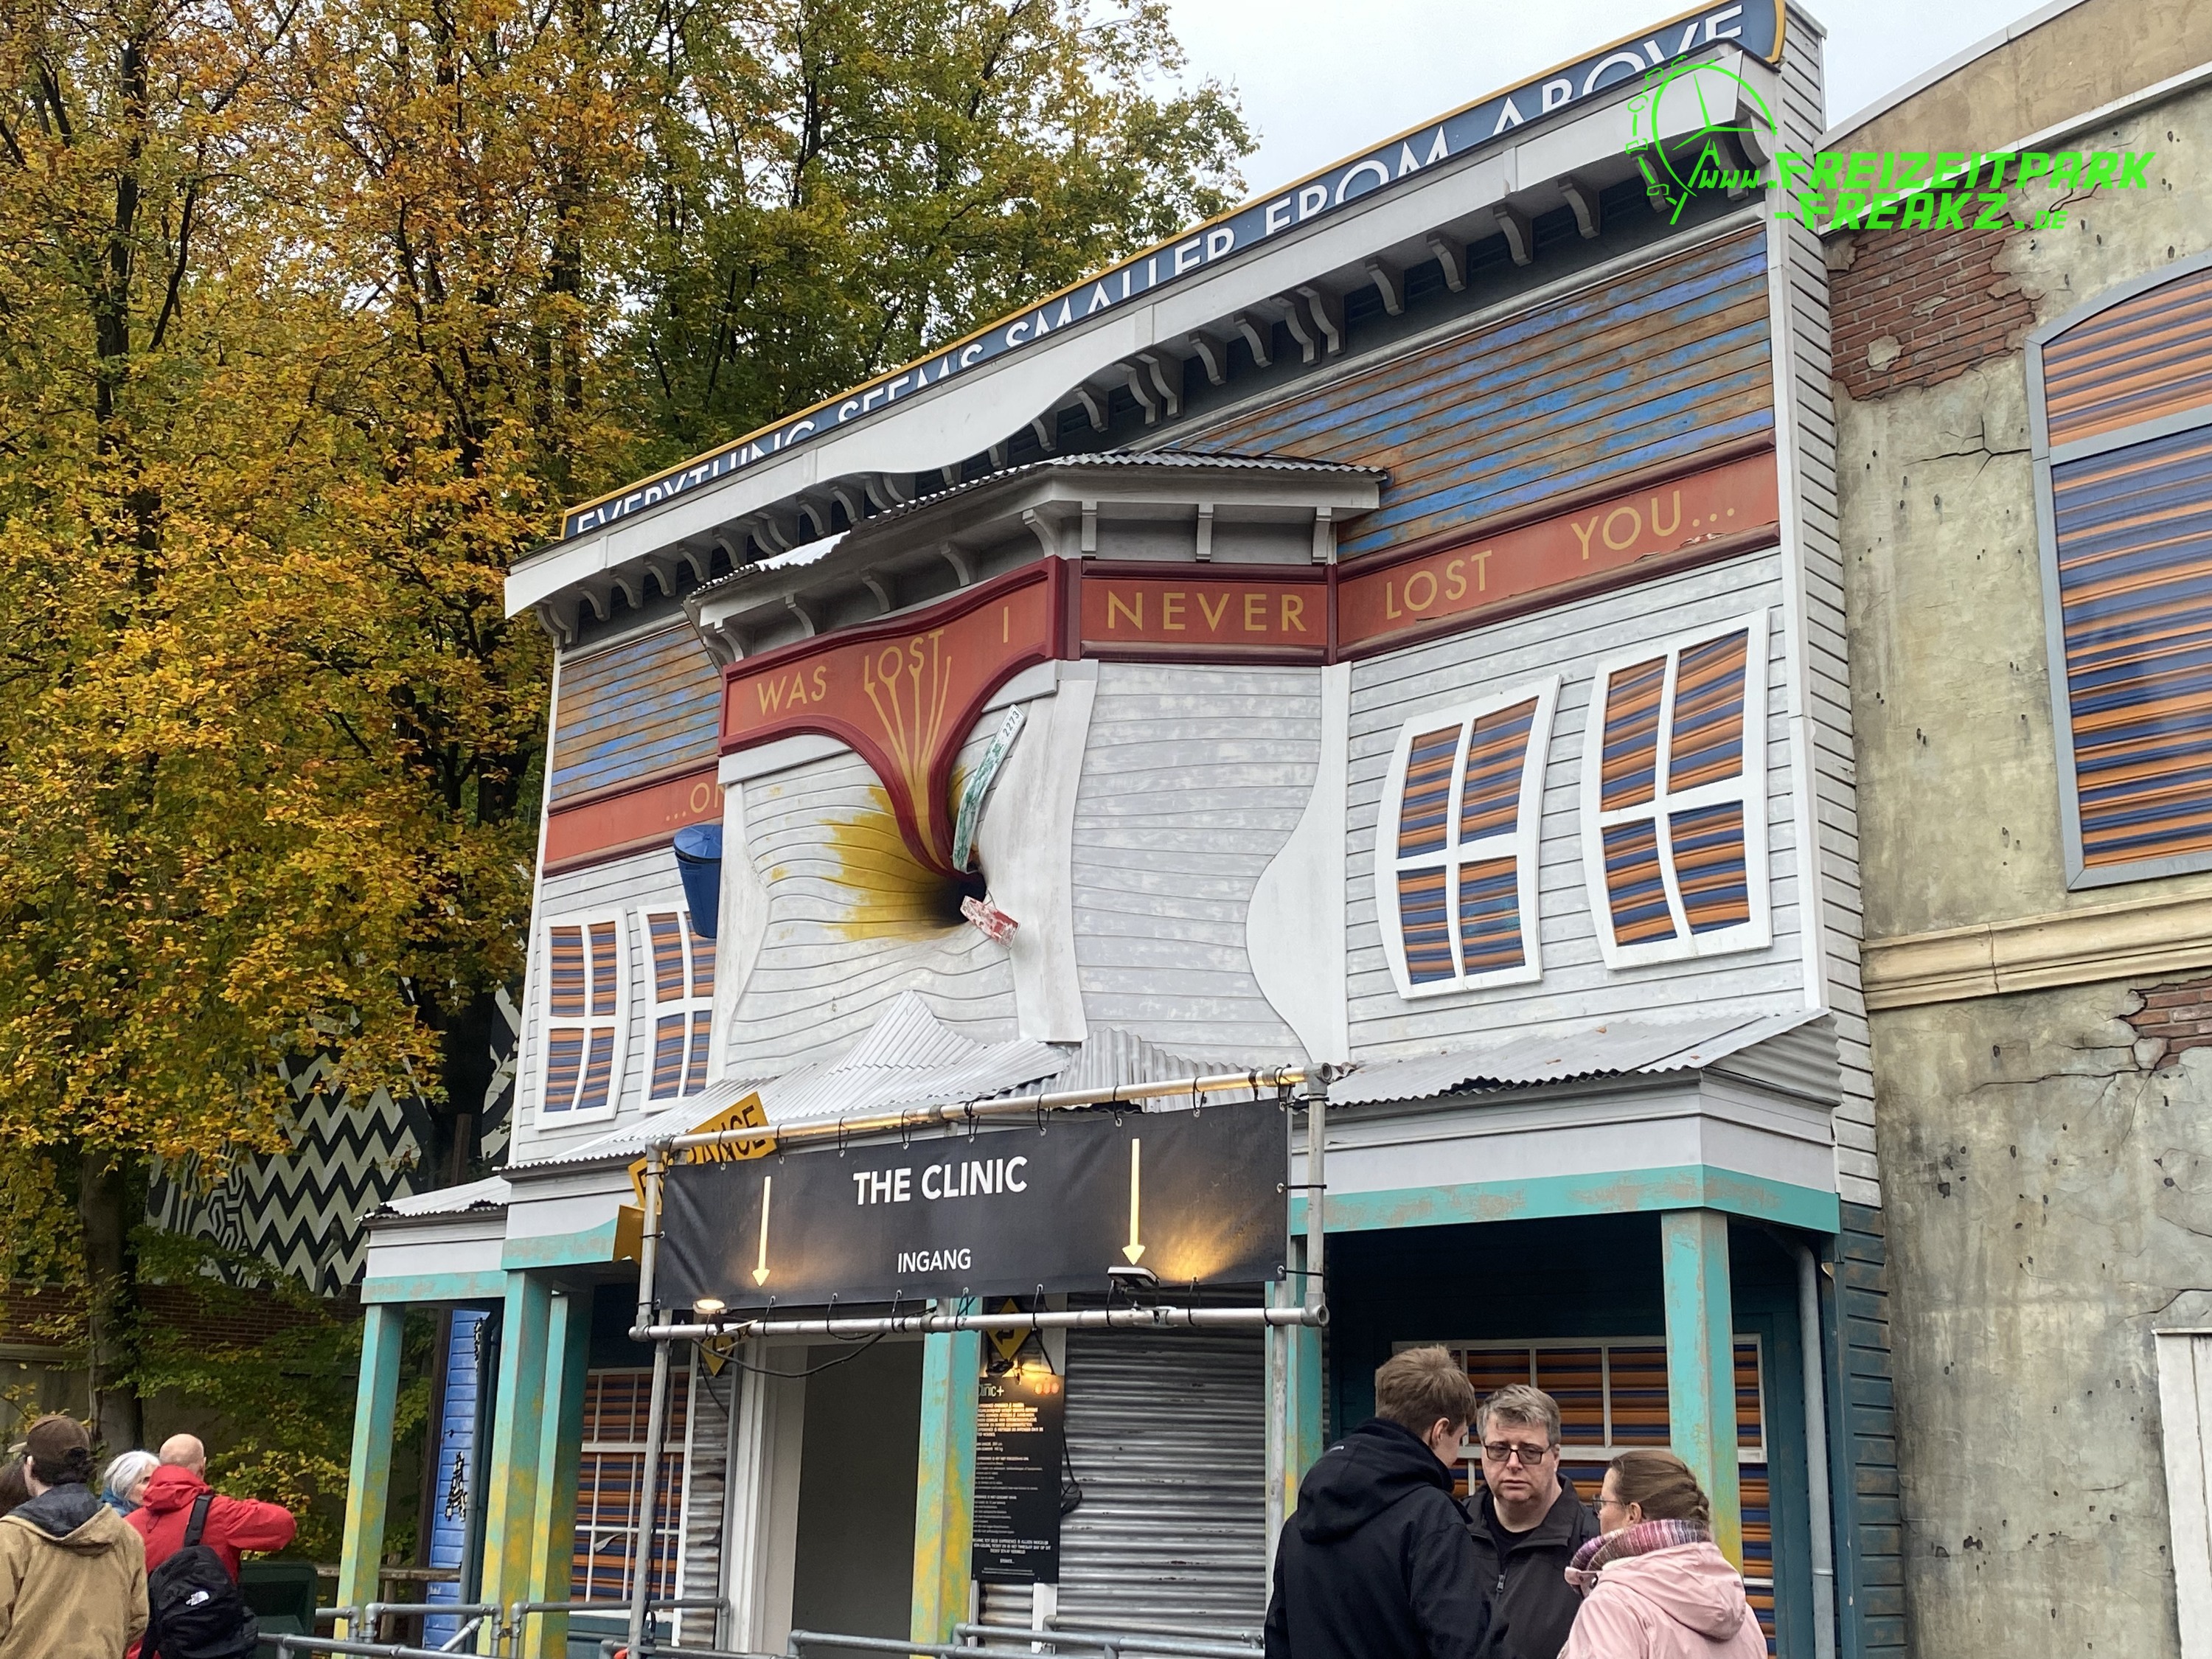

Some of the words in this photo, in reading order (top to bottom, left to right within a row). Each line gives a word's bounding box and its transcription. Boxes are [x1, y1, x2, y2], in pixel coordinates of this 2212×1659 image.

[1386, 550, 1492, 620] LOST
[1571, 490, 1735, 560] YOU...
[1107, 590, 1307, 632] NEVER
[757, 666, 827, 716] WAS
[1003, 606, 1009, 644] I
[1002, 710, 1020, 737] 2273
[852, 1168, 911, 1206] THE
[922, 1156, 1028, 1200] CLINIC
[897, 1248, 971, 1273] INGANG
